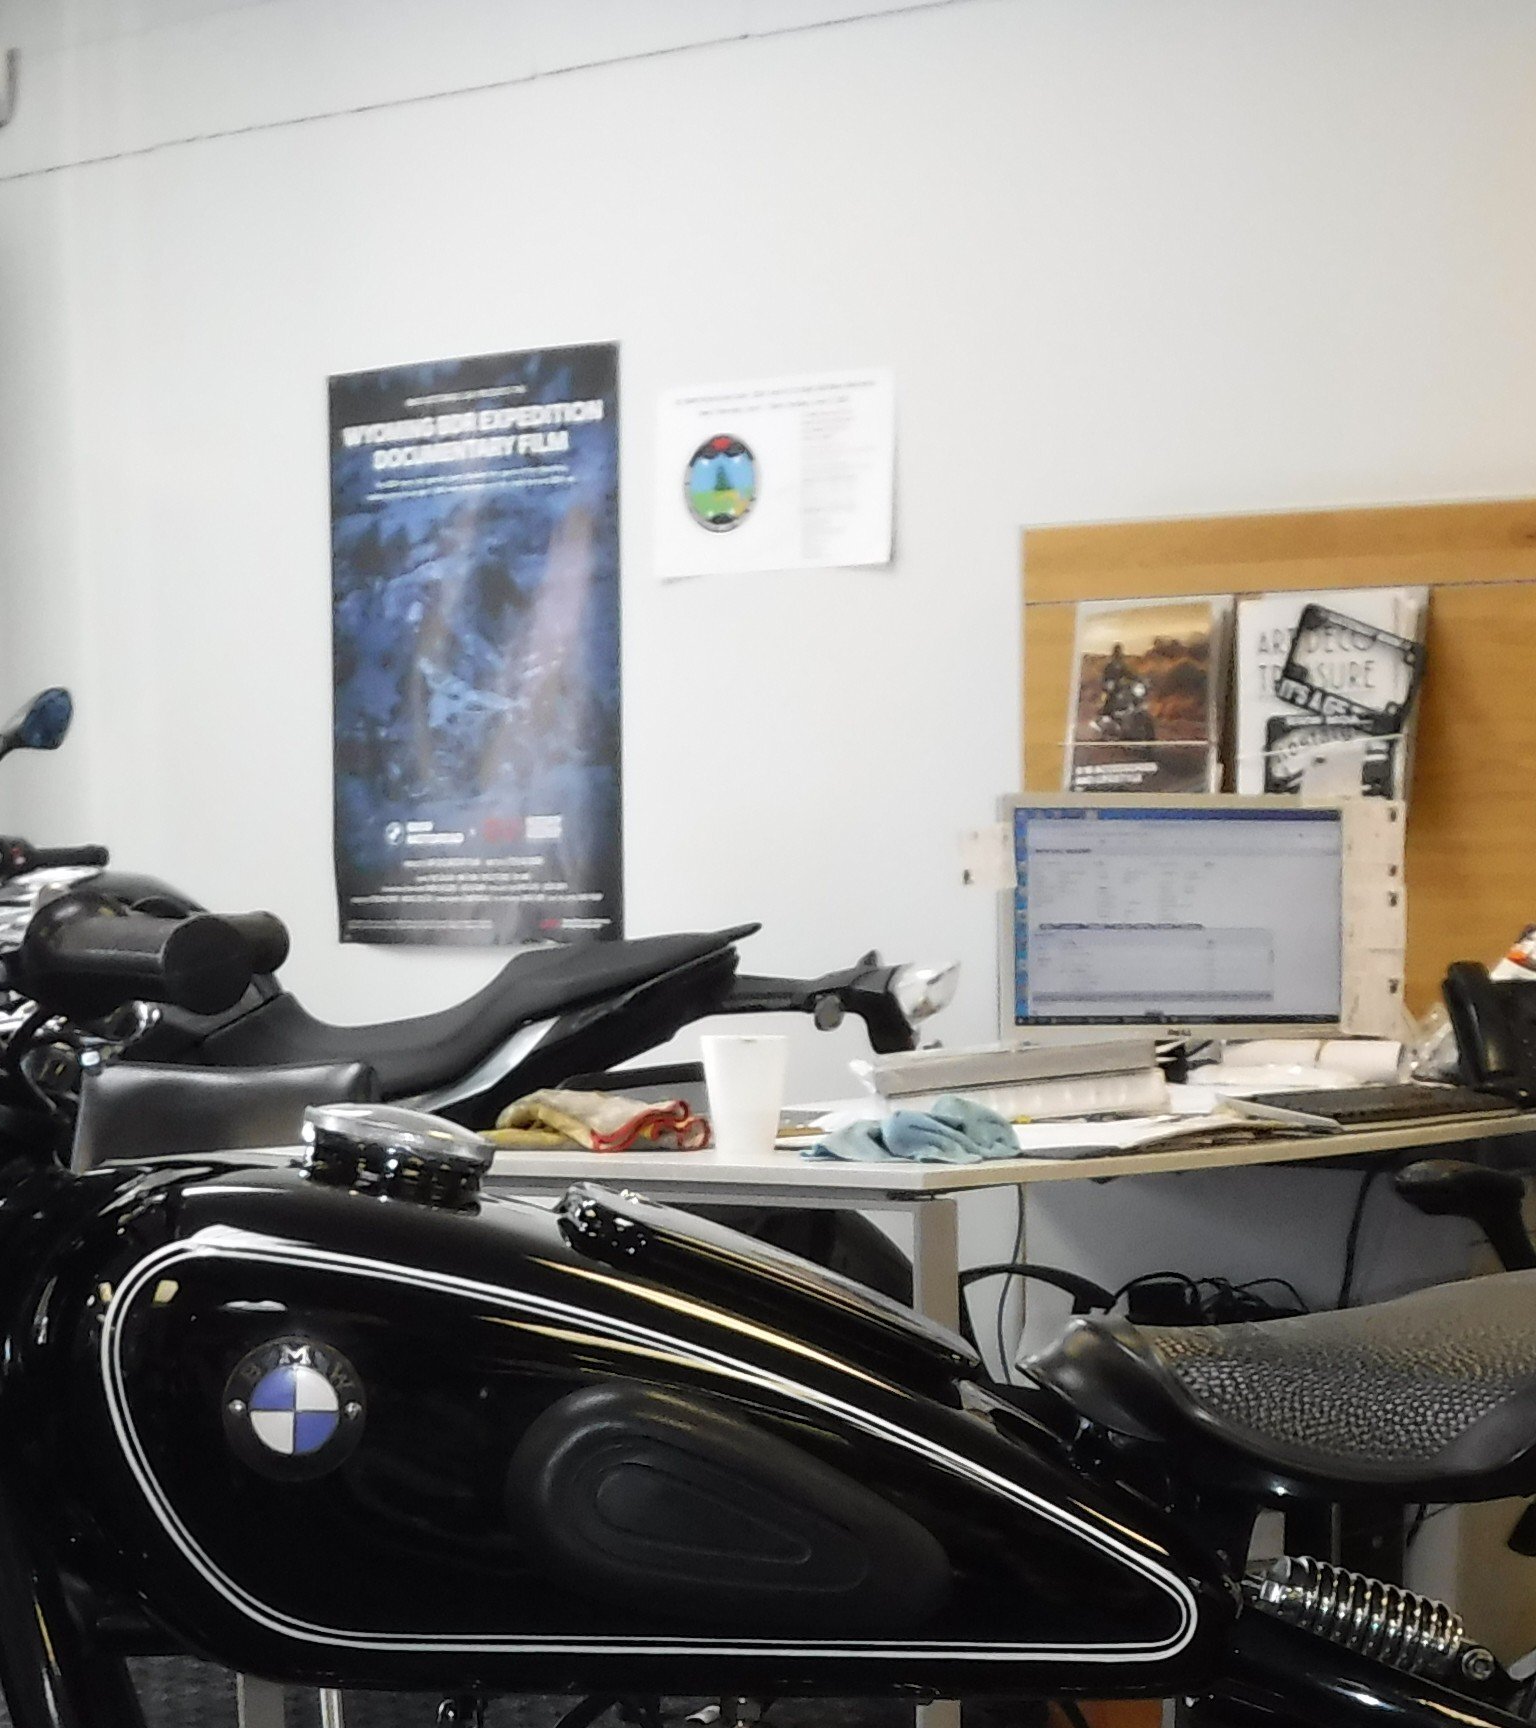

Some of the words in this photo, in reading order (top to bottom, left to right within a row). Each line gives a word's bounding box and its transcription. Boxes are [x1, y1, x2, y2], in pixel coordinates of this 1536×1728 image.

[343, 416, 437, 447] WYOMING
[478, 399, 604, 430] EXPEDITION
[372, 435, 514, 470] DOCUMENTARY
[517, 430, 570, 454] FILM
[240, 1345, 354, 1389] BMW
